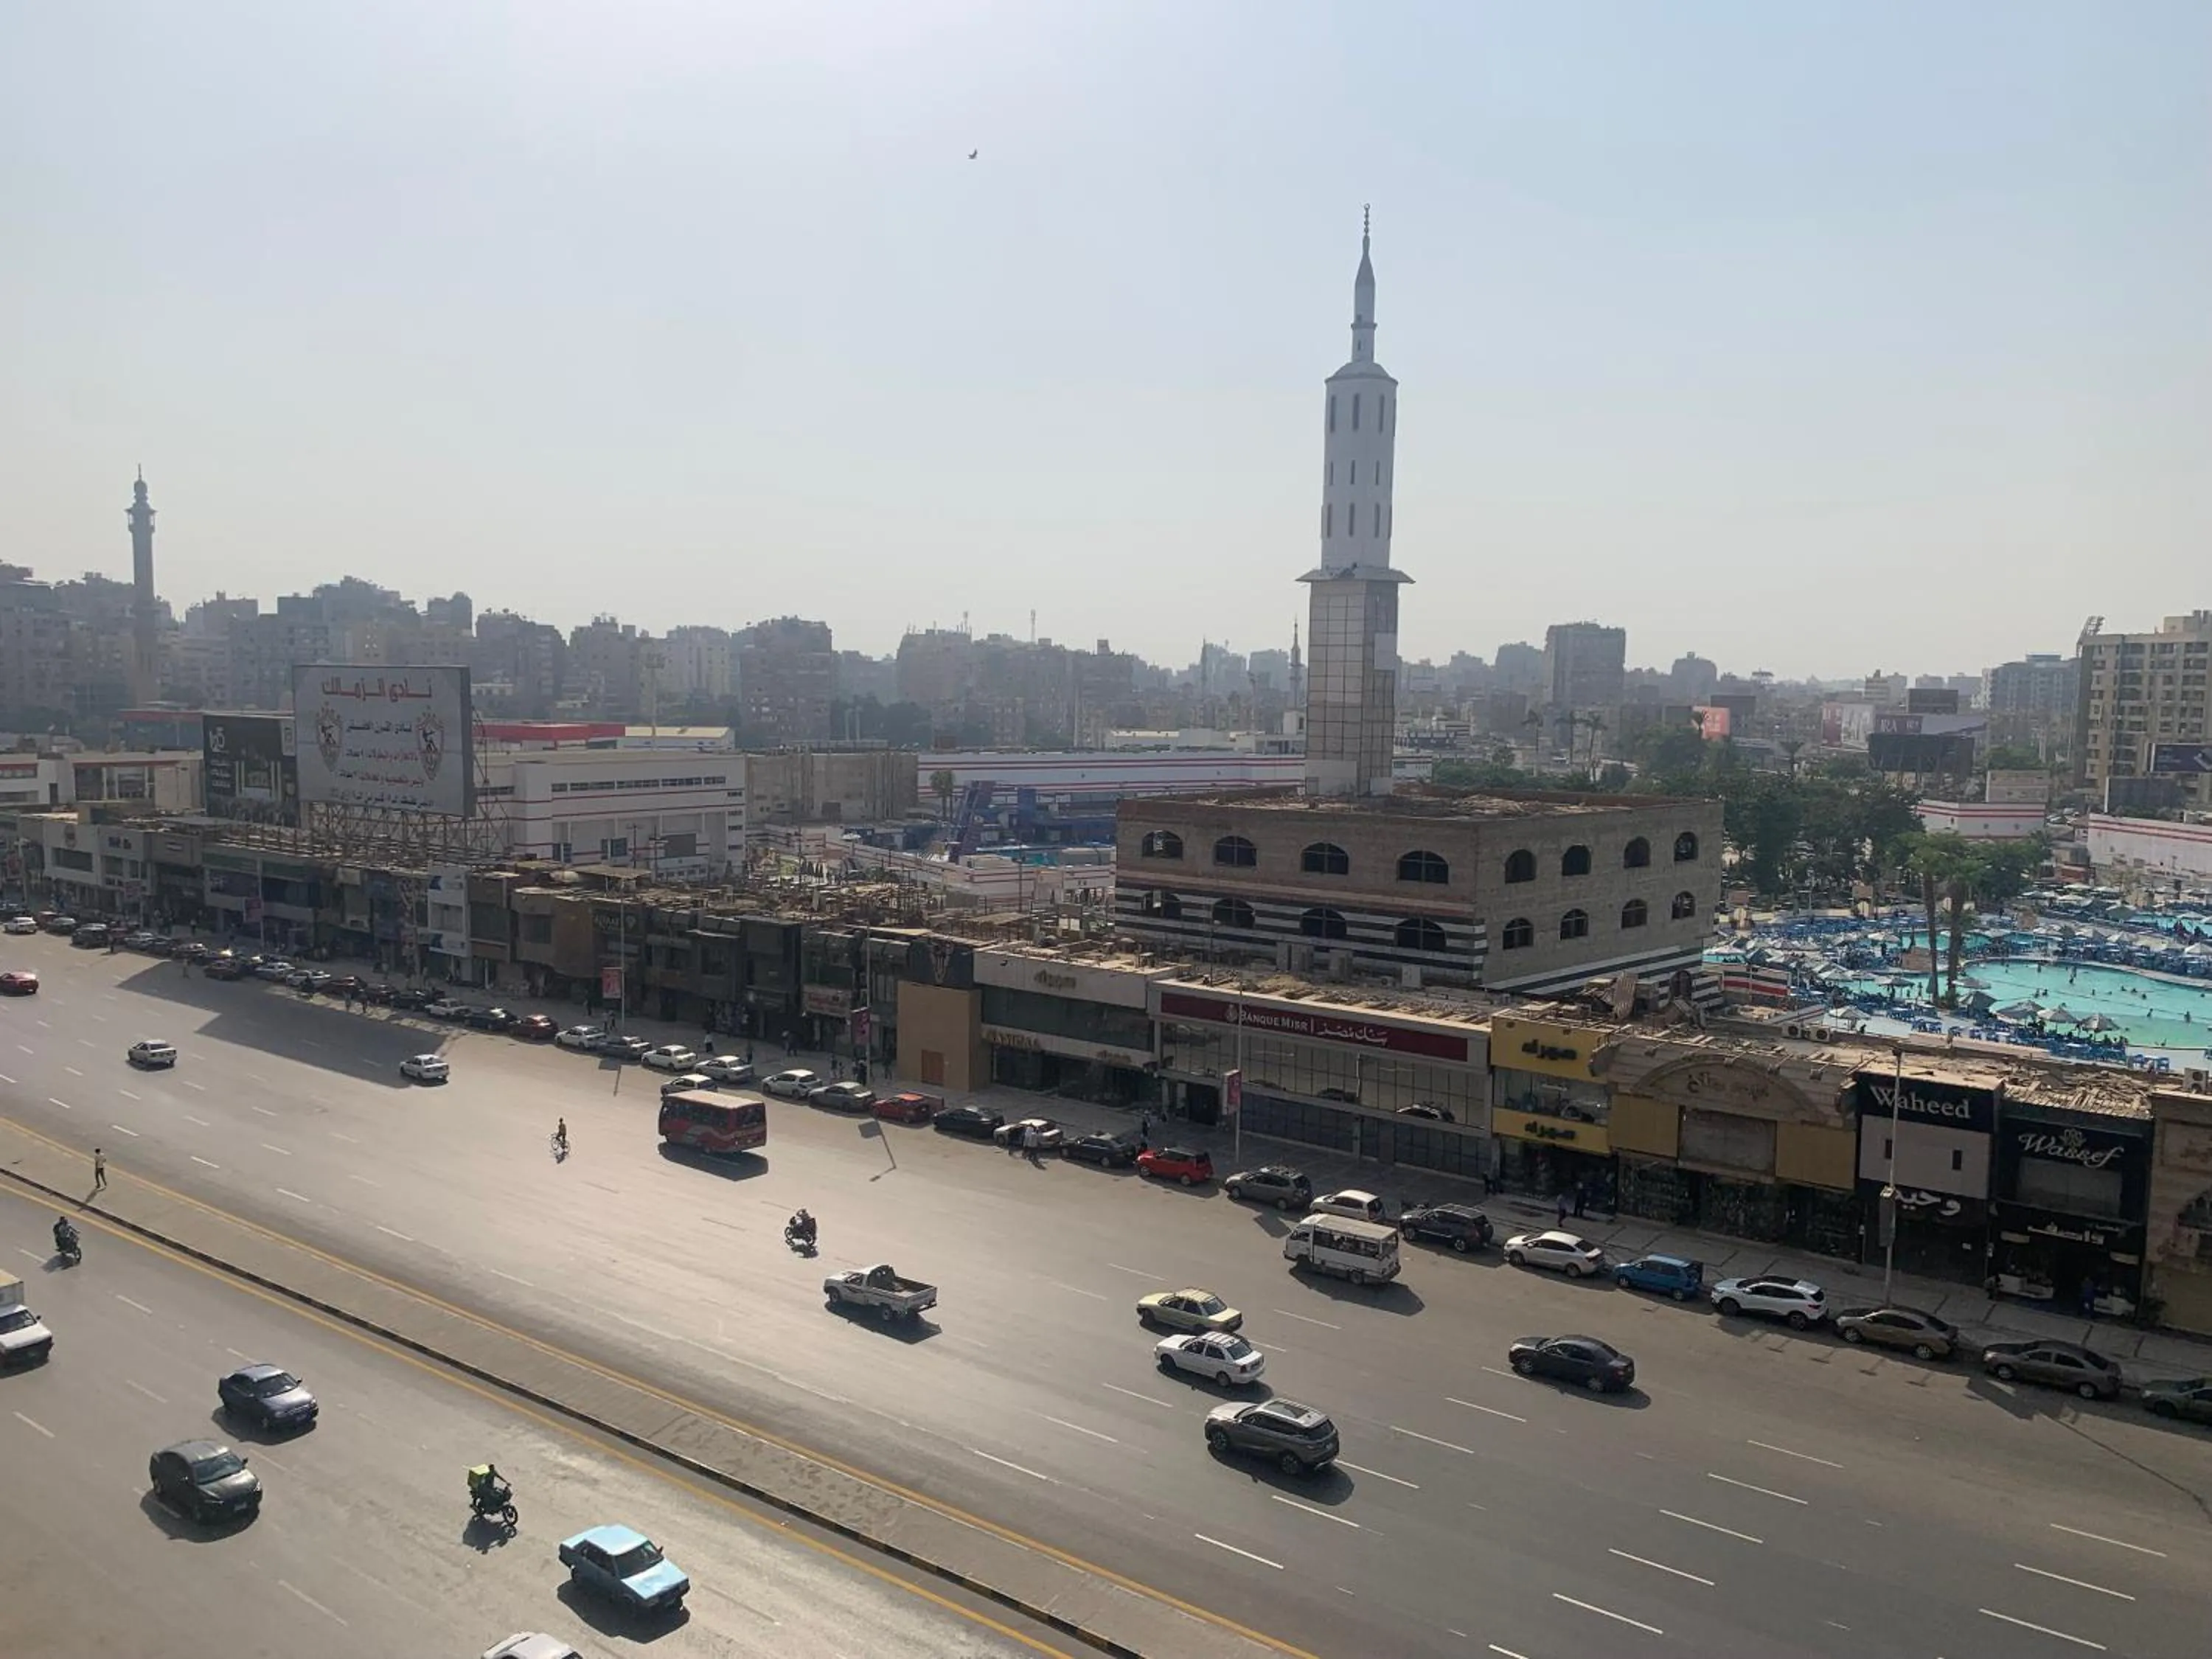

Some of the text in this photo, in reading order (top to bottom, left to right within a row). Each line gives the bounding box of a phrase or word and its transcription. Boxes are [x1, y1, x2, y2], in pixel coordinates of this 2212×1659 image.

[322, 676, 386, 701] الزمالك
[1869, 1085, 1971, 1119] Waheed
[2018, 1133, 2125, 1168] Wassef
